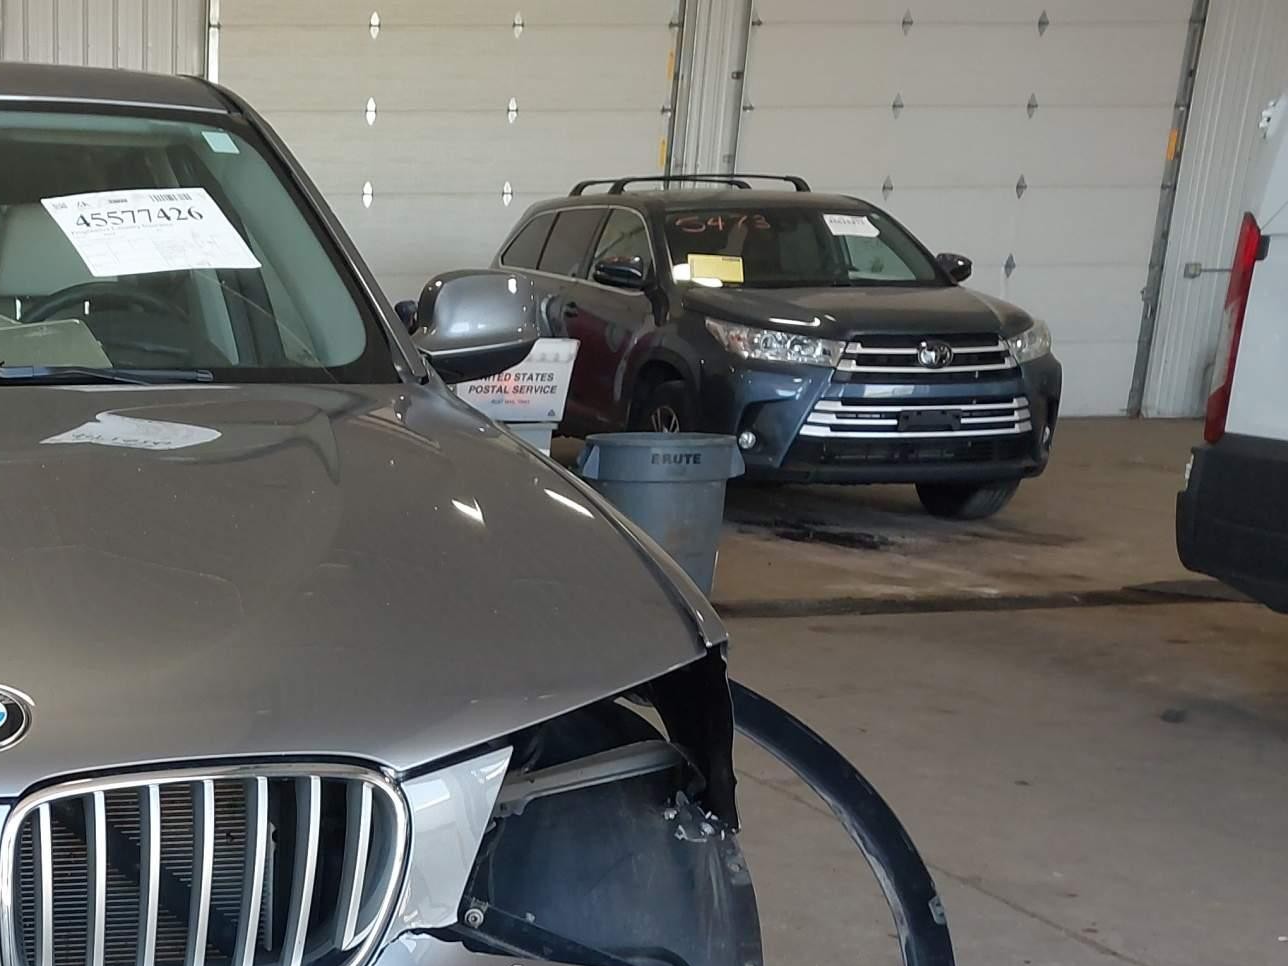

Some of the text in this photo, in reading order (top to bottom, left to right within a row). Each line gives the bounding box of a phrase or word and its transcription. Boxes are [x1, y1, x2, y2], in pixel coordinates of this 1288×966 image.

[76, 206, 204, 228] 45577426
[513, 372, 555, 382] STATES
[468, 384, 558, 395] POSTAL SERVICE
